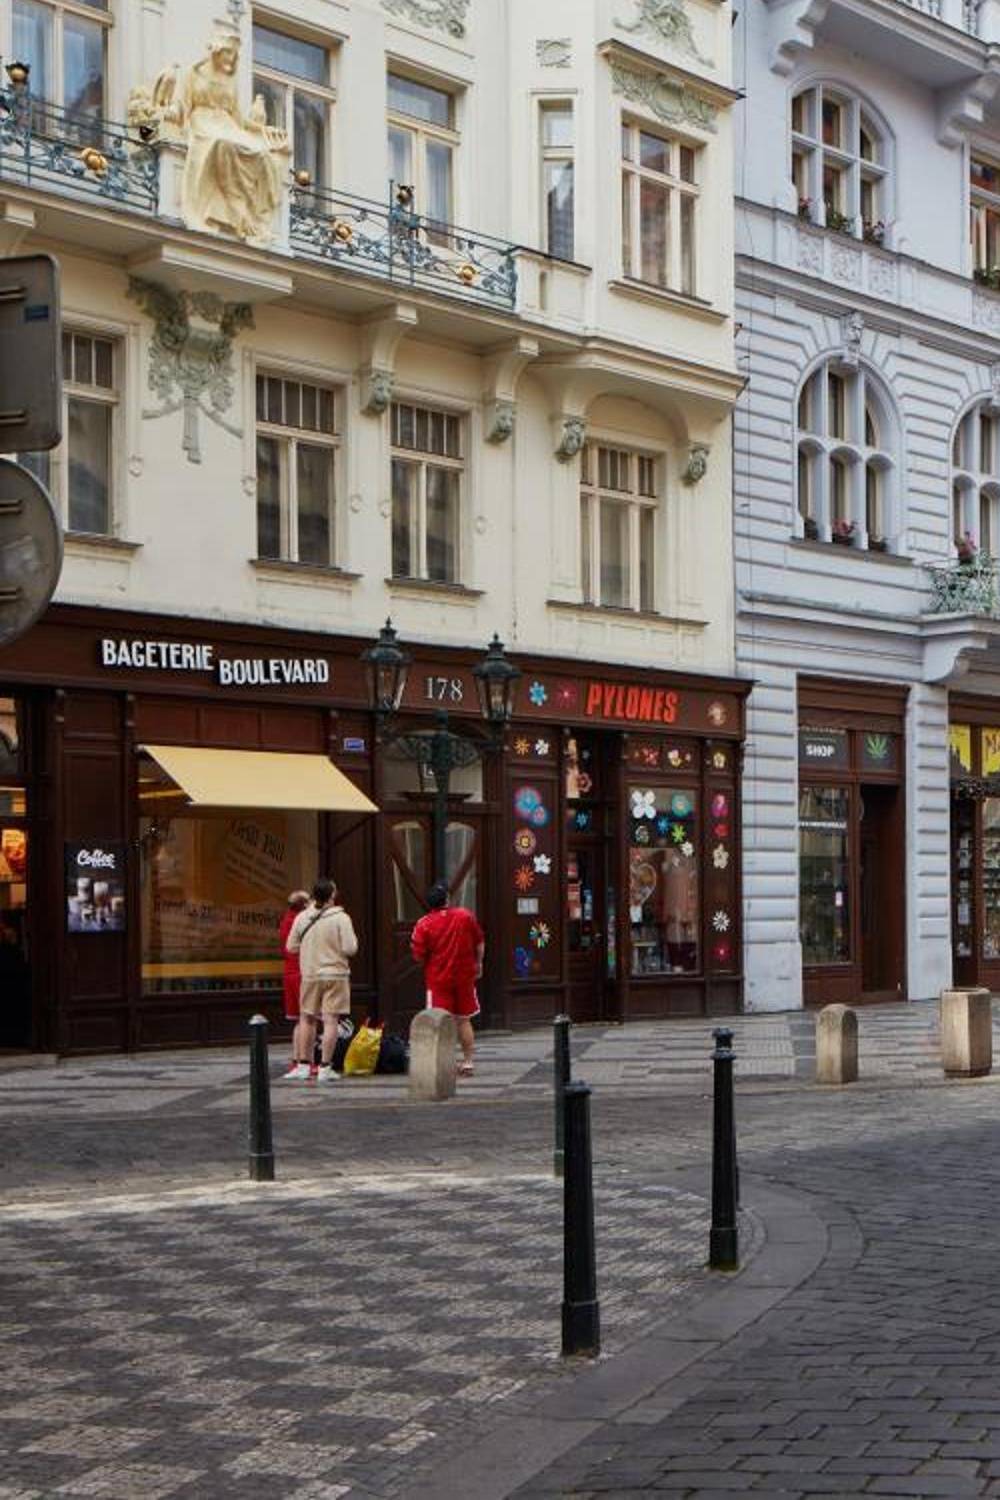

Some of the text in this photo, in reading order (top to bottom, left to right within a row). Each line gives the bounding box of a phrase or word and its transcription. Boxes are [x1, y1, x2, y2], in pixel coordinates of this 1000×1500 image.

[102, 638, 329, 685] BAGETERIE BOULEVARD
[425, 676, 463, 701] 178
[586, 681, 678, 723] PYLONES
[805, 743, 836, 757] SHOP
[77, 849, 116, 869] Coffee
